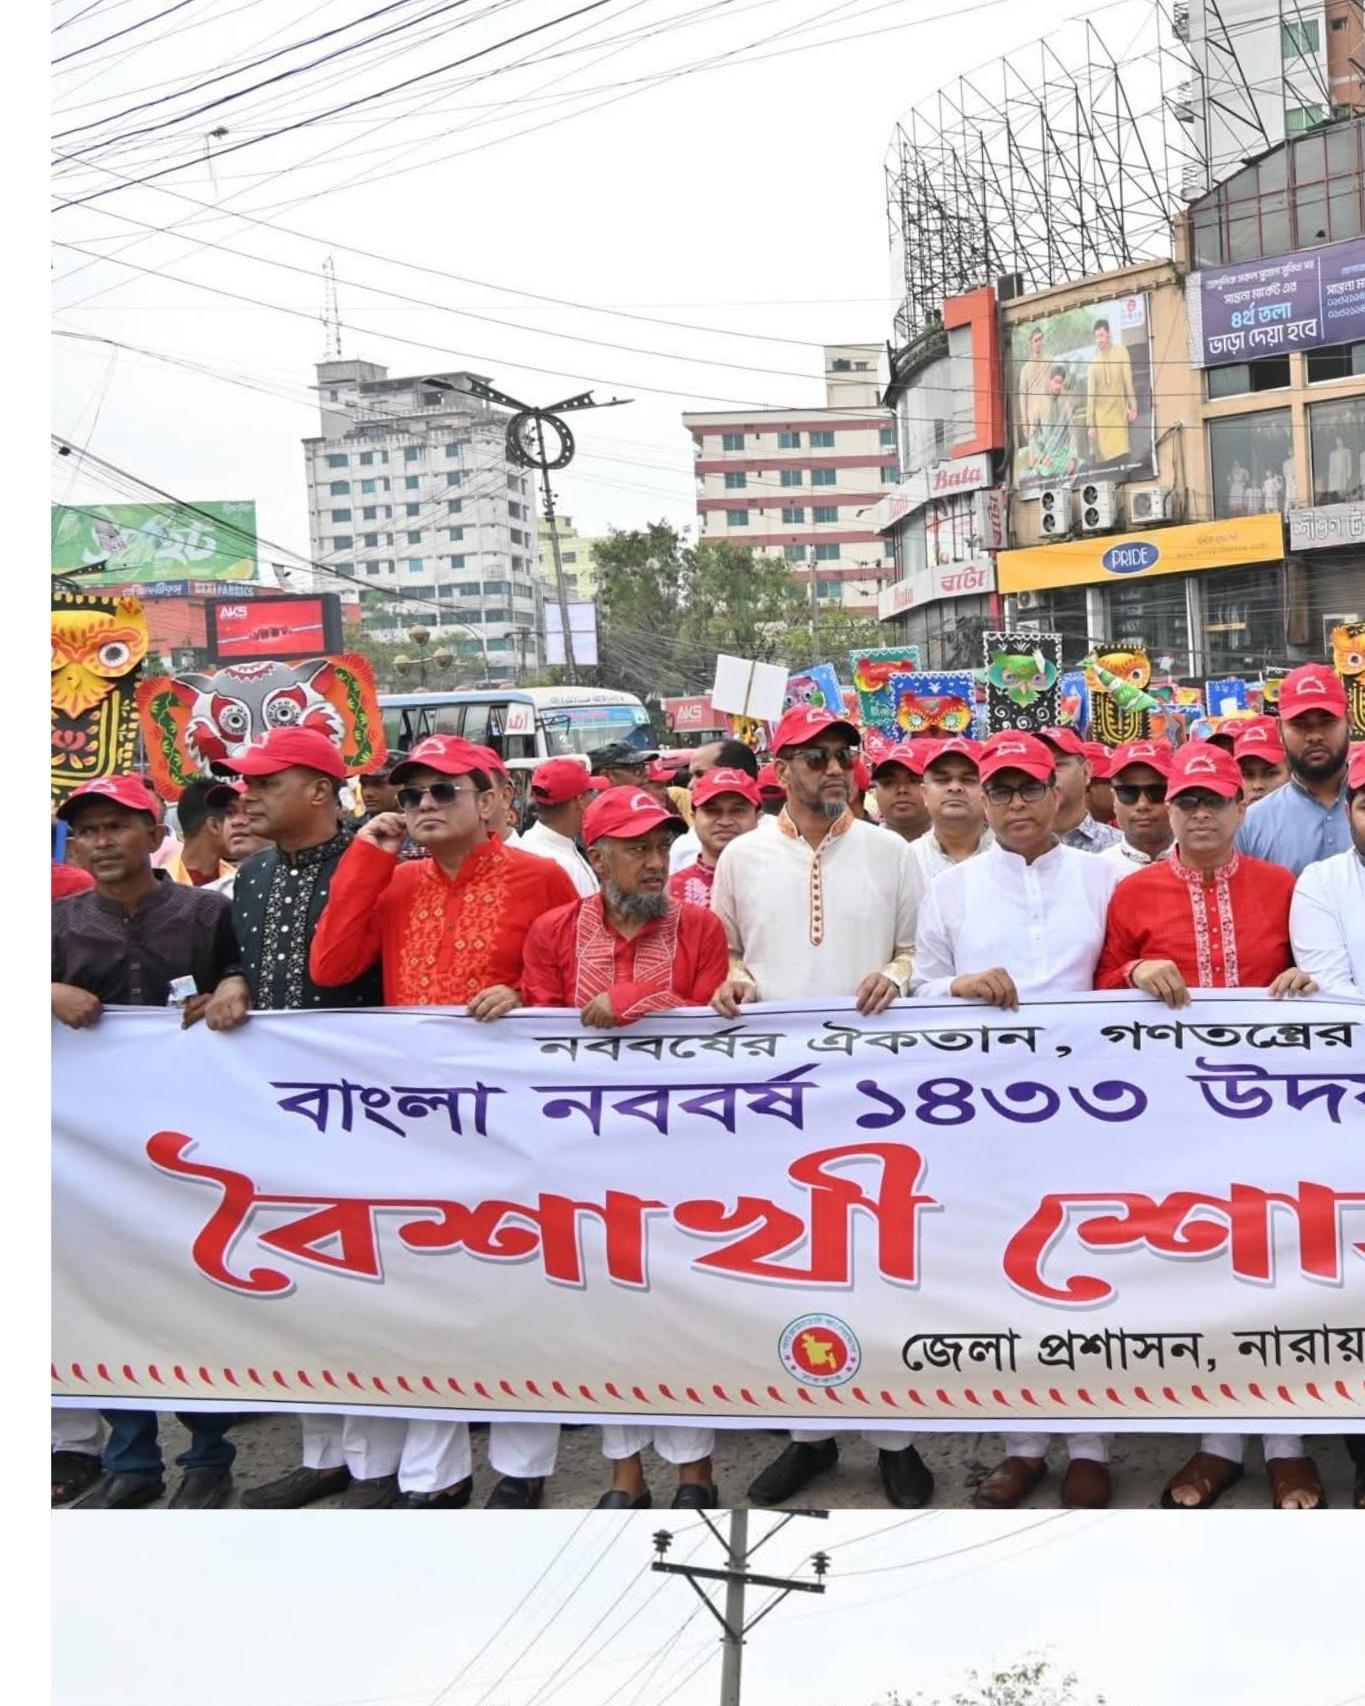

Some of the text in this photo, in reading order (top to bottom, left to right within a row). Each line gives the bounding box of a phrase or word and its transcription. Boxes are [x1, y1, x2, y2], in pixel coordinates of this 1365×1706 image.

[1230, 301, 1293, 330] ৪র্থ তলা
[1207, 318, 1319, 355] ভাড়া দেয়া হবে
[932, 466, 984, 492] Bata
[1111, 545, 1151, 570] PRIDE
[940, 566, 986, 593] বাটা
[218, 605, 249, 618] AKS
[677, 703, 703, 722] AKS
[532, 1024, 787, 1062] নববর্ষের
[1100, 1018, 1363, 1054] গণতন্ত্রের
[269, 1076, 505, 1138] বাংলা
[529, 1062, 823, 1138] নববর্ষ
[855, 1075, 1148, 1130] ১৪৩৩
[145, 1130, 945, 1300] বৈশাখী
[902, 1326, 1021, 1373] জেলা
[1037, 1328, 1216, 1373] প্রশাসন,
